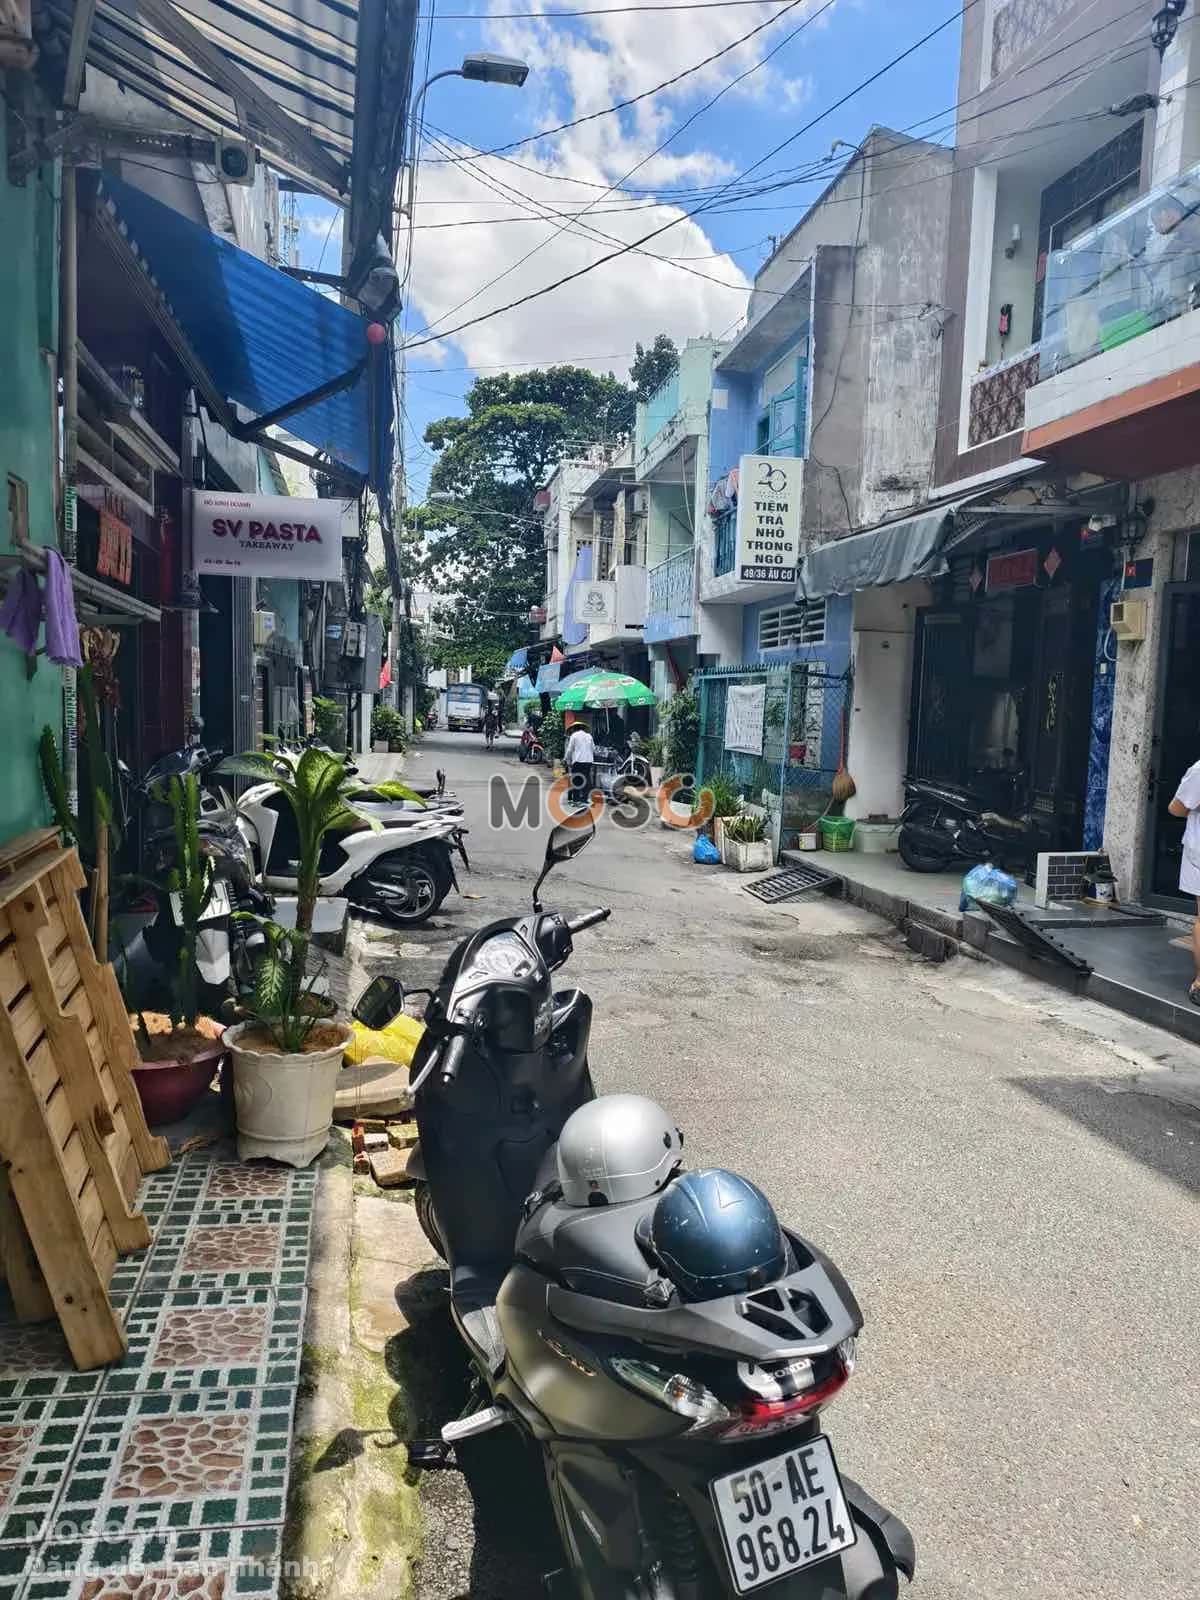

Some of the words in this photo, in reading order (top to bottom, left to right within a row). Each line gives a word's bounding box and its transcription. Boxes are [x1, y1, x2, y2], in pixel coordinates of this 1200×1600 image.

[754, 499, 789, 514] TIỆM
[212, 518, 243, 538] SV
[247, 520, 323, 544] PASTA
[238, 540, 295, 551] TAKEAWAY
[746, 540, 793, 552] TRONG
[730, 1447, 825, 1524] 50-AE
[736, 1498, 845, 1582] 968.24
